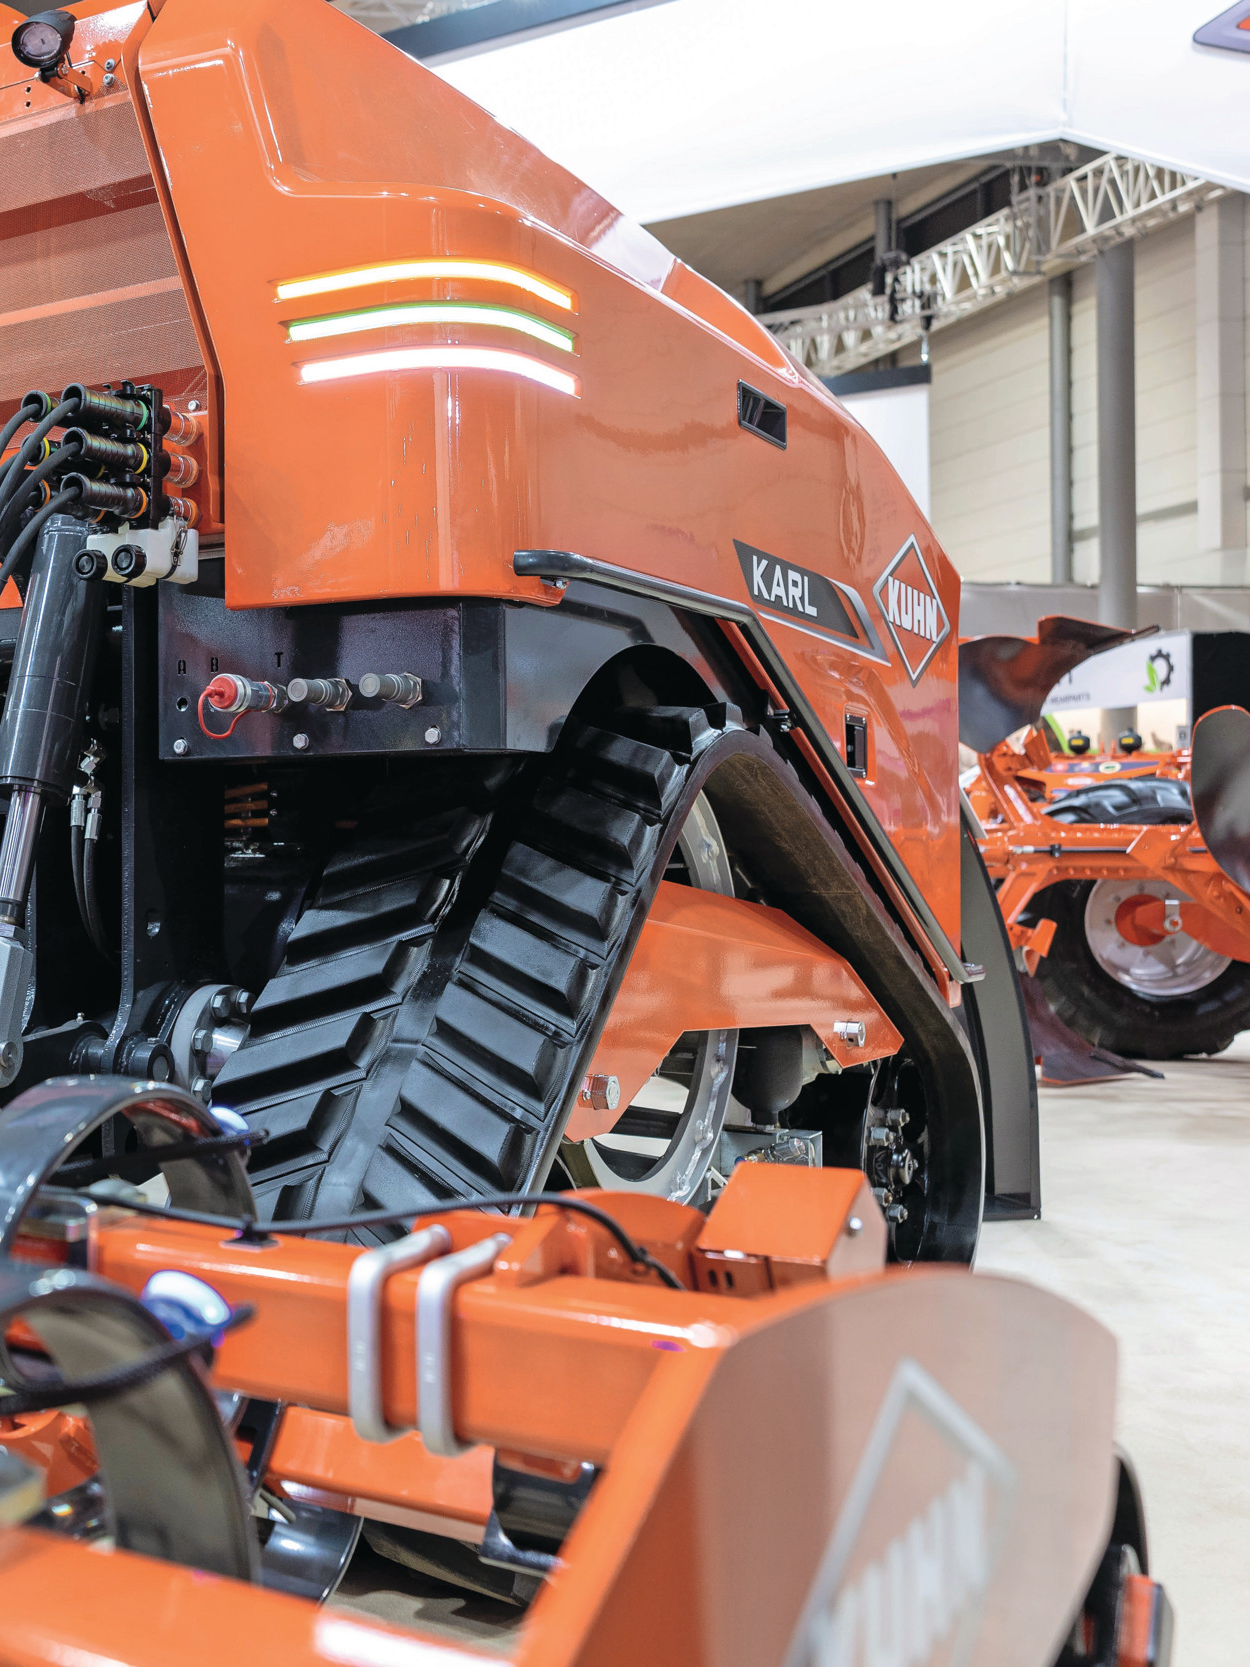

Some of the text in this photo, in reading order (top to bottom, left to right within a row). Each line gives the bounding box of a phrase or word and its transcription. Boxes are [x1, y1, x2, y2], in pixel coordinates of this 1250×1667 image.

[753, 555, 817, 617] KARL
[888, 576, 937, 643] KUHN
[178, 651, 283, 675] A B T
